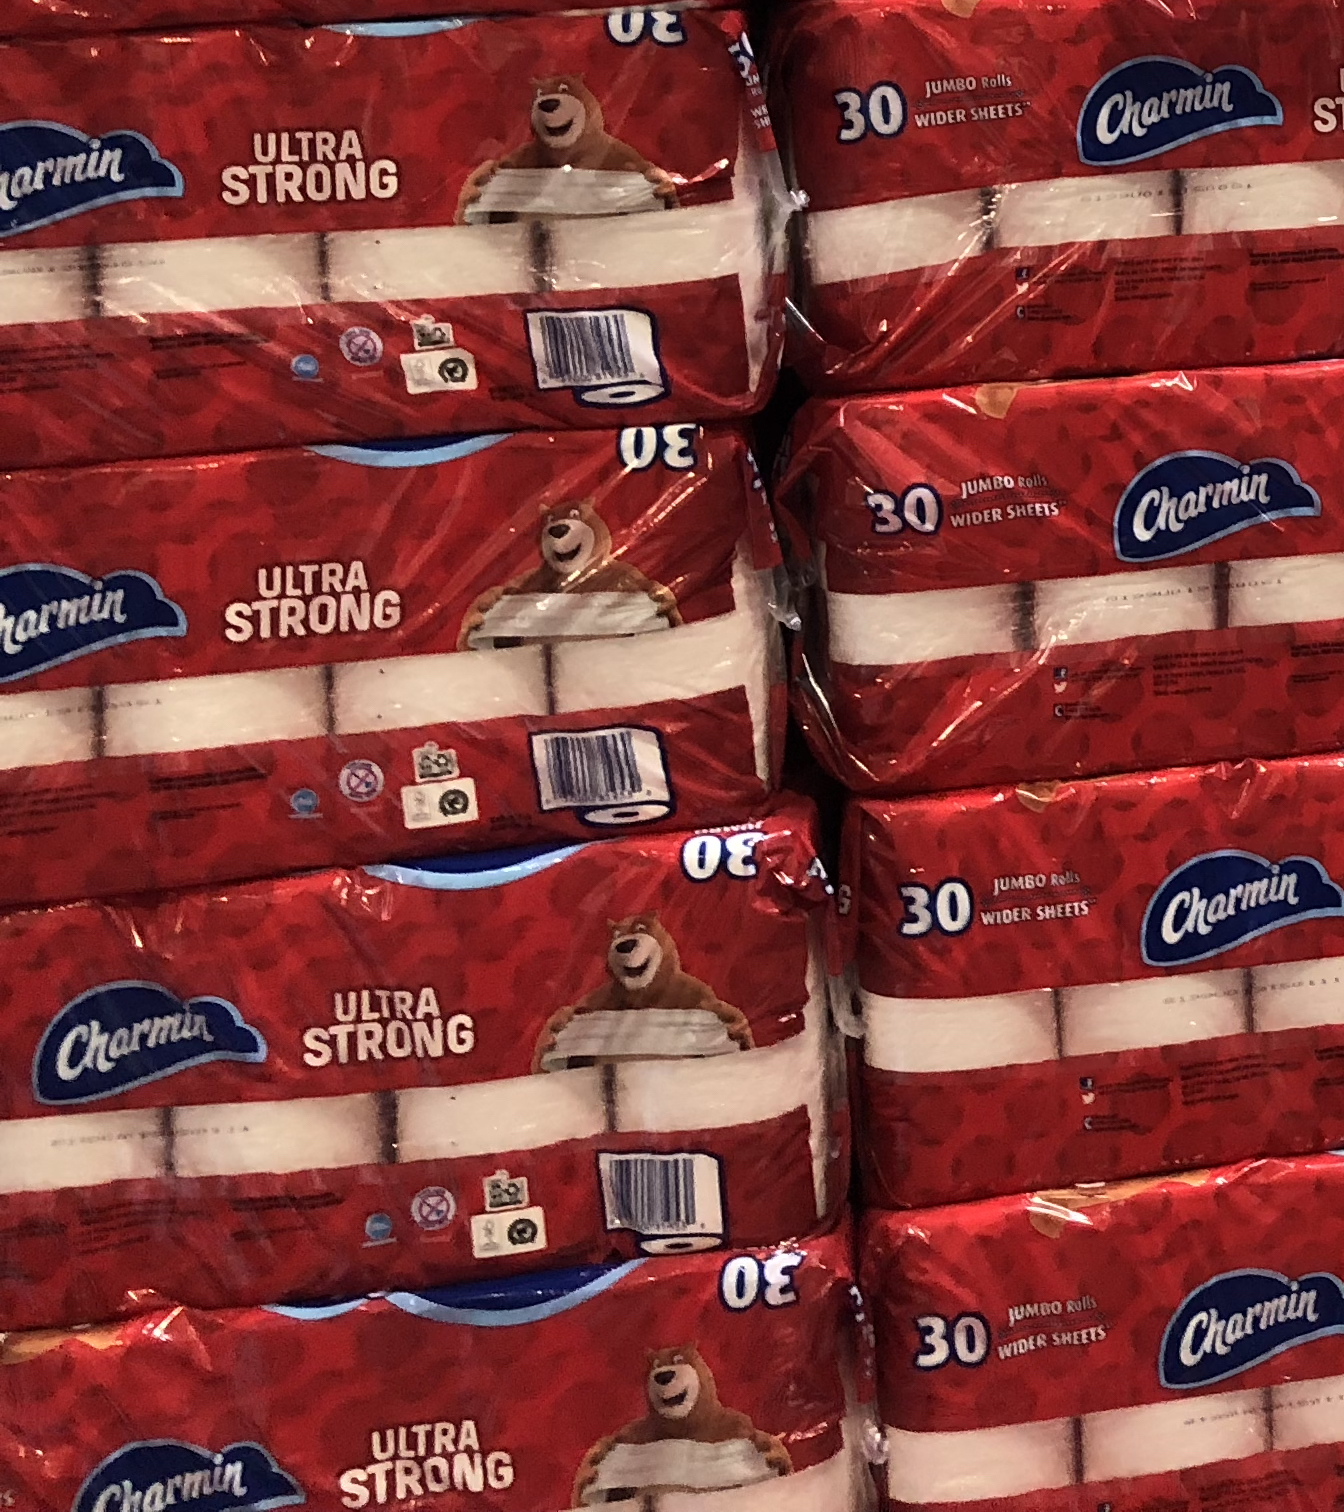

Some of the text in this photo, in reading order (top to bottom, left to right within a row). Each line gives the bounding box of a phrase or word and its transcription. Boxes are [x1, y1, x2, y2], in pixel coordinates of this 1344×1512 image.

[833, 73, 1012, 142] 30 JUMBO Rolls
[914, 106, 968, 128] WIDER
[1095, 67, 1234, 145] Charmin
[334, 986, 441, 1023] ULTRA
[55, 1010, 213, 1081] Charmin
[303, 1012, 475, 1068] STRONG
